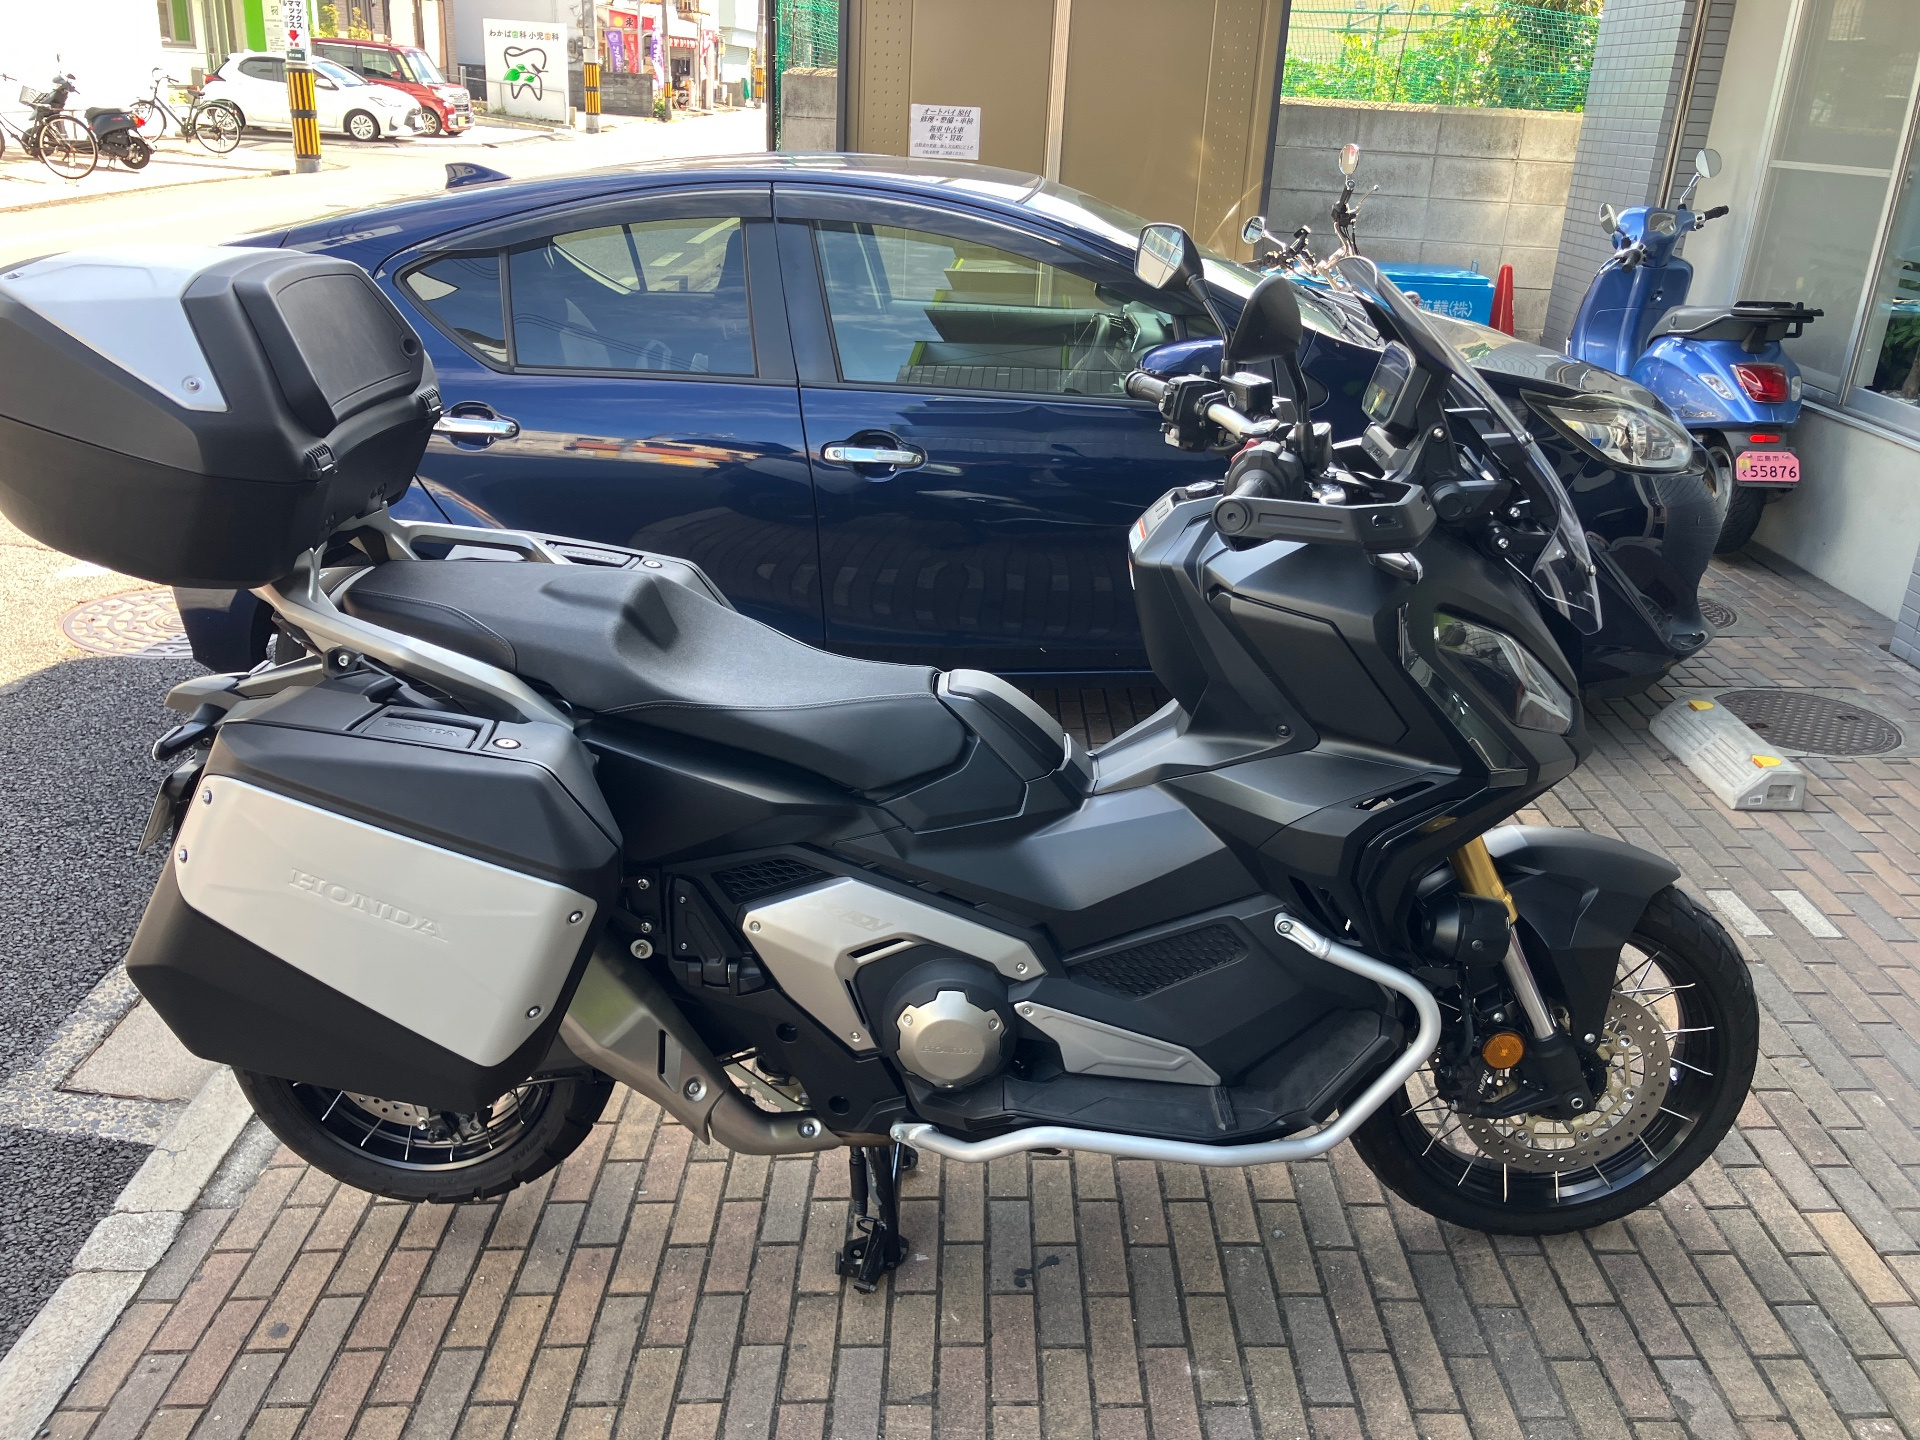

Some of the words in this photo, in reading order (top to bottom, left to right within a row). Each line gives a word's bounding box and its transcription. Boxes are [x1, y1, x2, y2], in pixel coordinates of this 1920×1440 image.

[489, 29, 527, 39] わかば歯科
[528, 31, 559, 41] 小児歯科
[1750, 465, 1797, 478] 55876
[288, 867, 449, 943] HONDA
